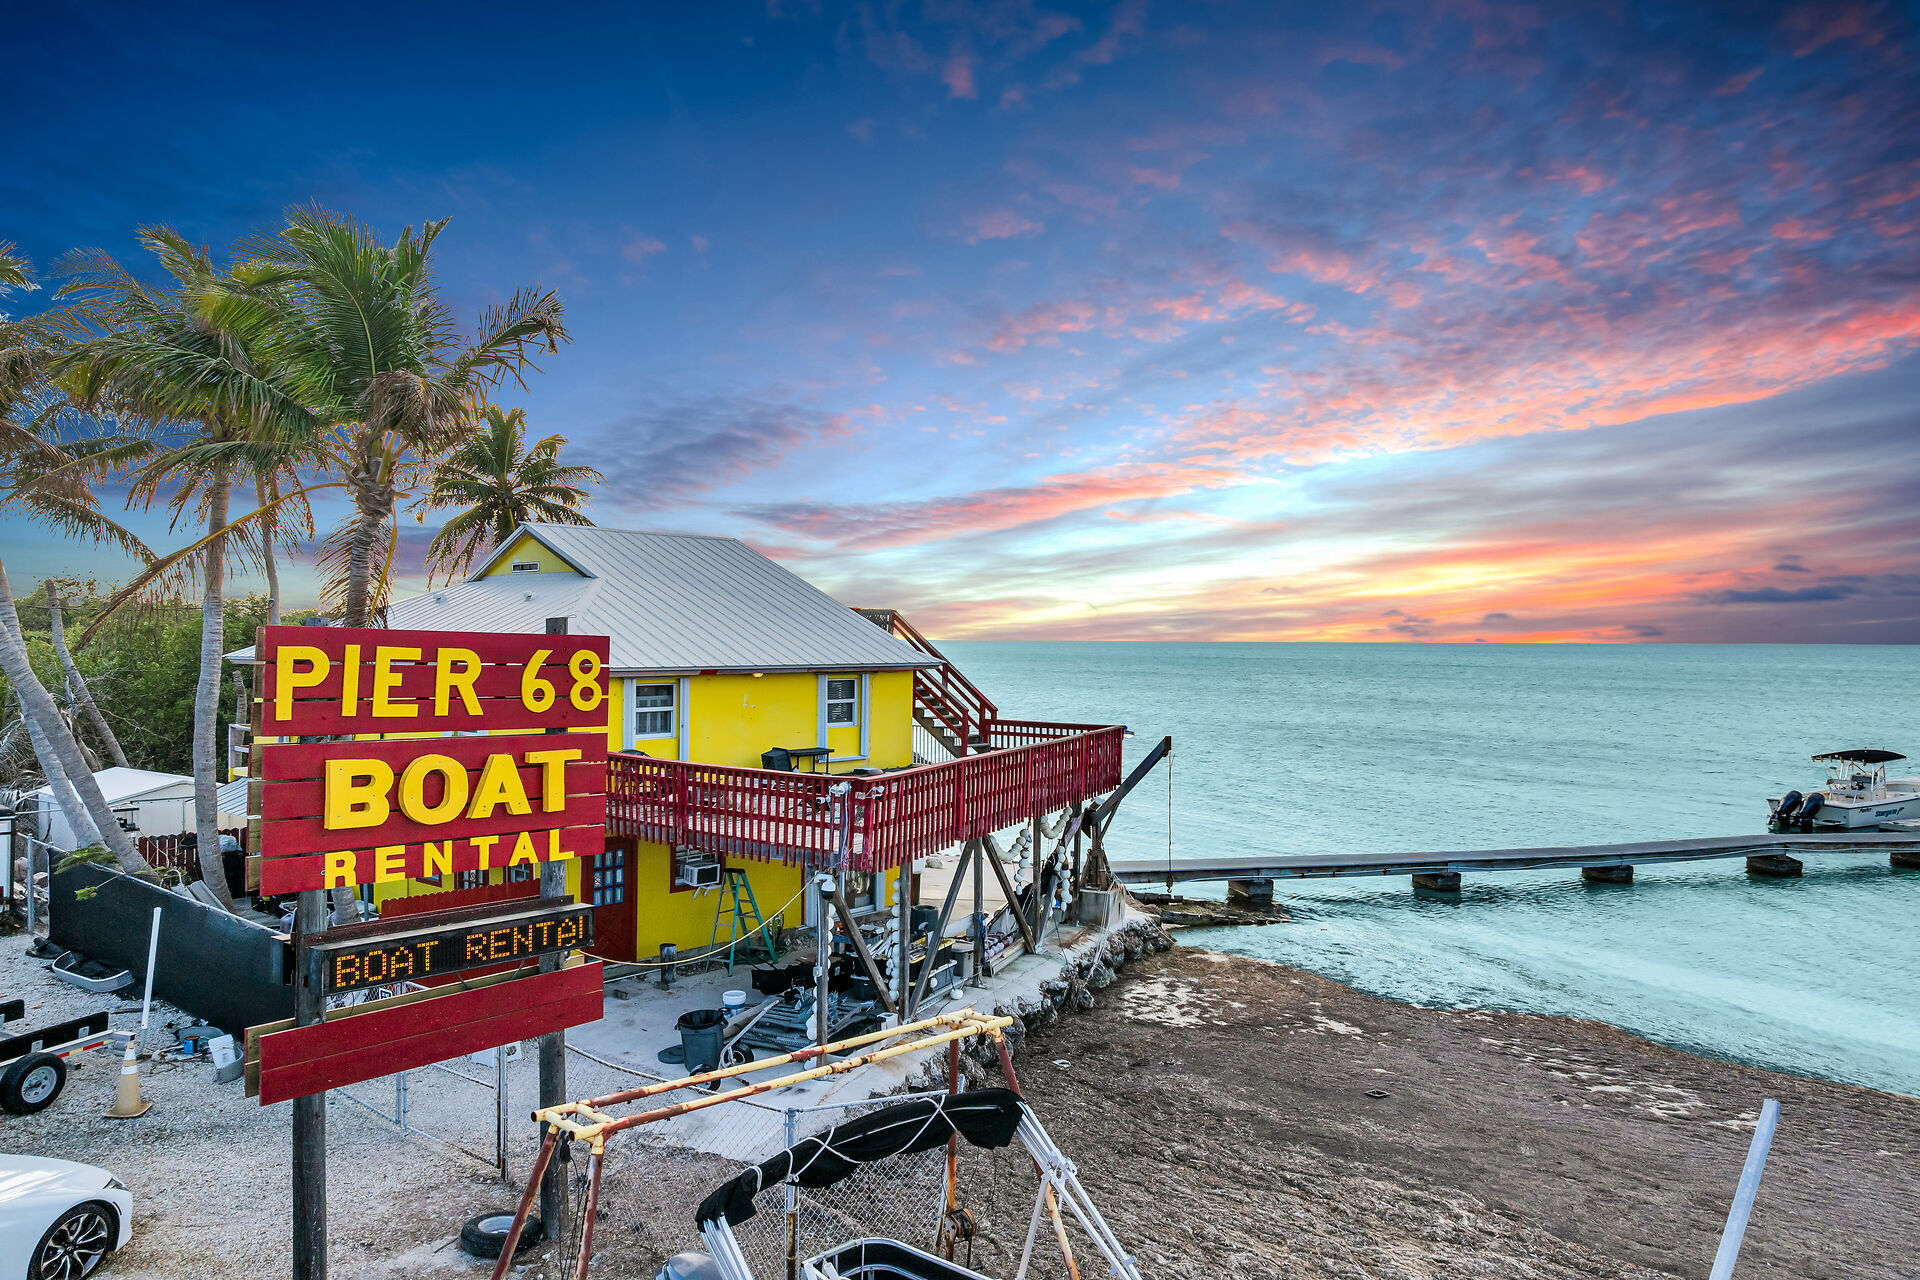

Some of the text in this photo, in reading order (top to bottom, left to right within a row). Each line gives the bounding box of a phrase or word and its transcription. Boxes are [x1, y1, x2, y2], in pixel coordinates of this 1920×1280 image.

[275, 644, 603, 721] PIER 68
[324, 748, 582, 830] BOAT
[324, 829, 575, 889] RENTAL
[336, 941, 439, 987] BOAT
